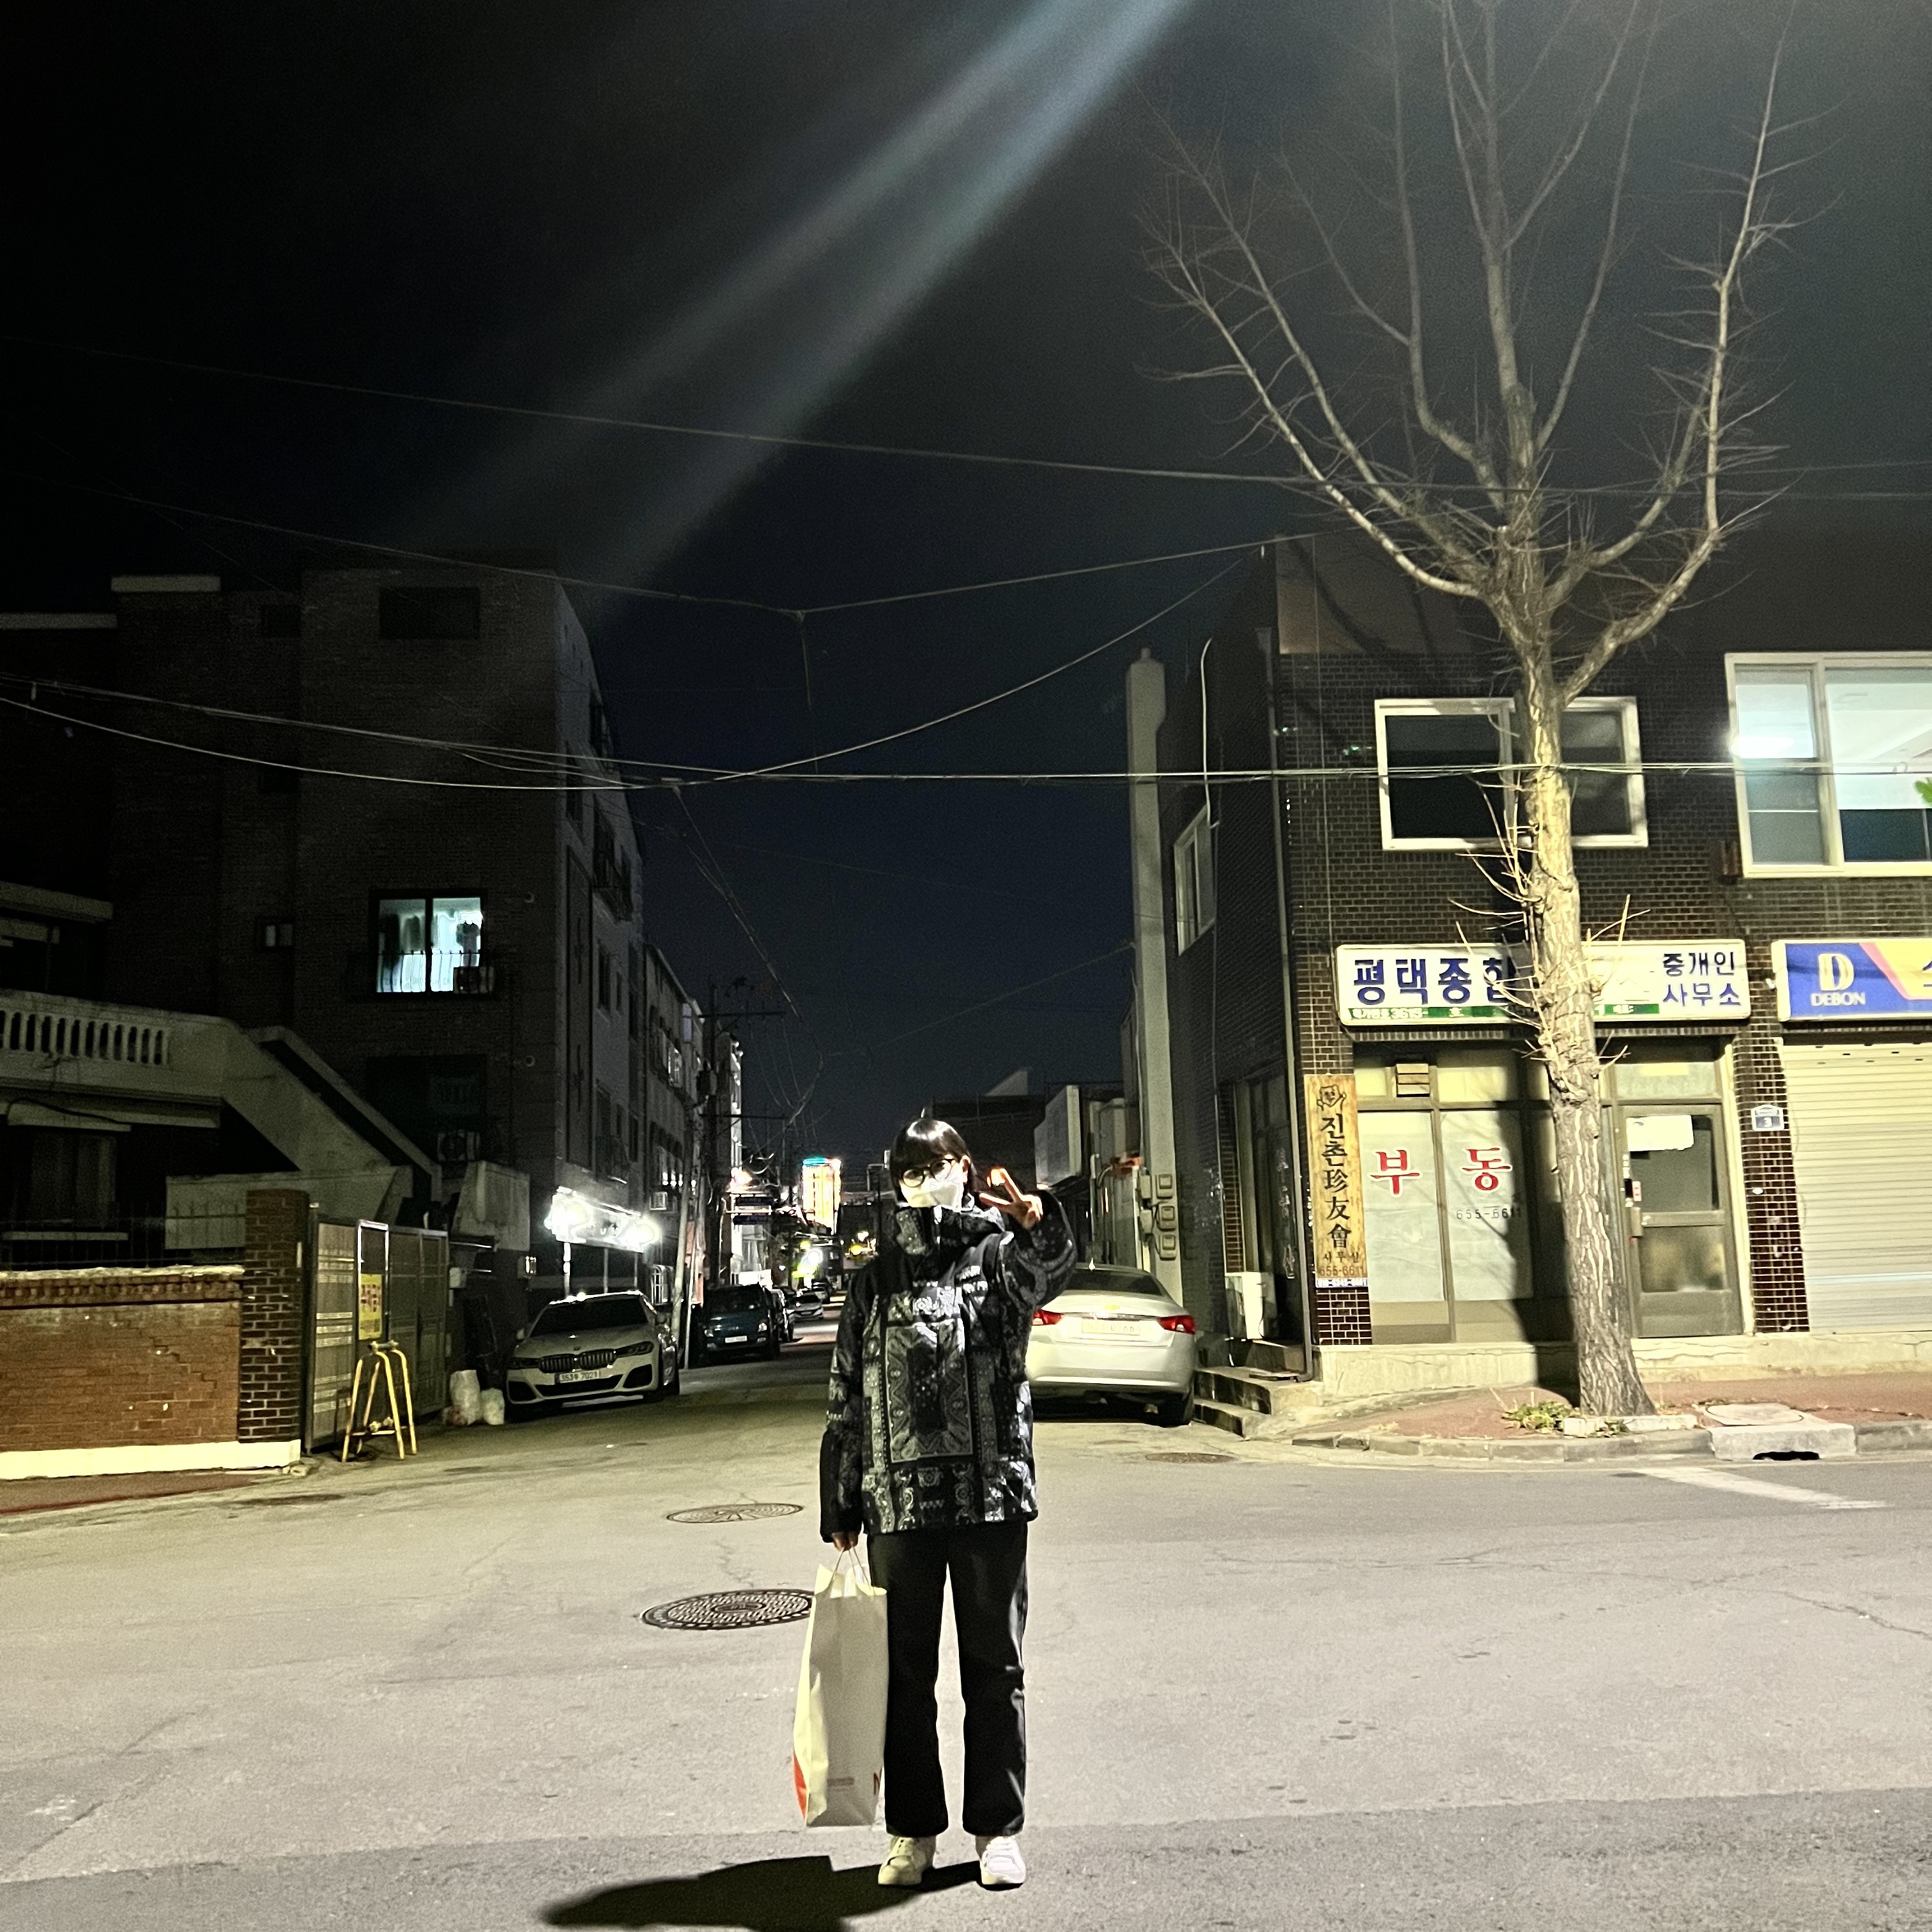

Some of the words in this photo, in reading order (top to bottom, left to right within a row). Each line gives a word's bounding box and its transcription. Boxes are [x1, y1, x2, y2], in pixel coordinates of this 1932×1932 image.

[1662, 951, 1735, 977] 중개인
[1662, 982, 1742, 1008] 사무소
[1810, 992, 1866, 1006] DEBON
[1764, 1117, 1772, 1128] 3
